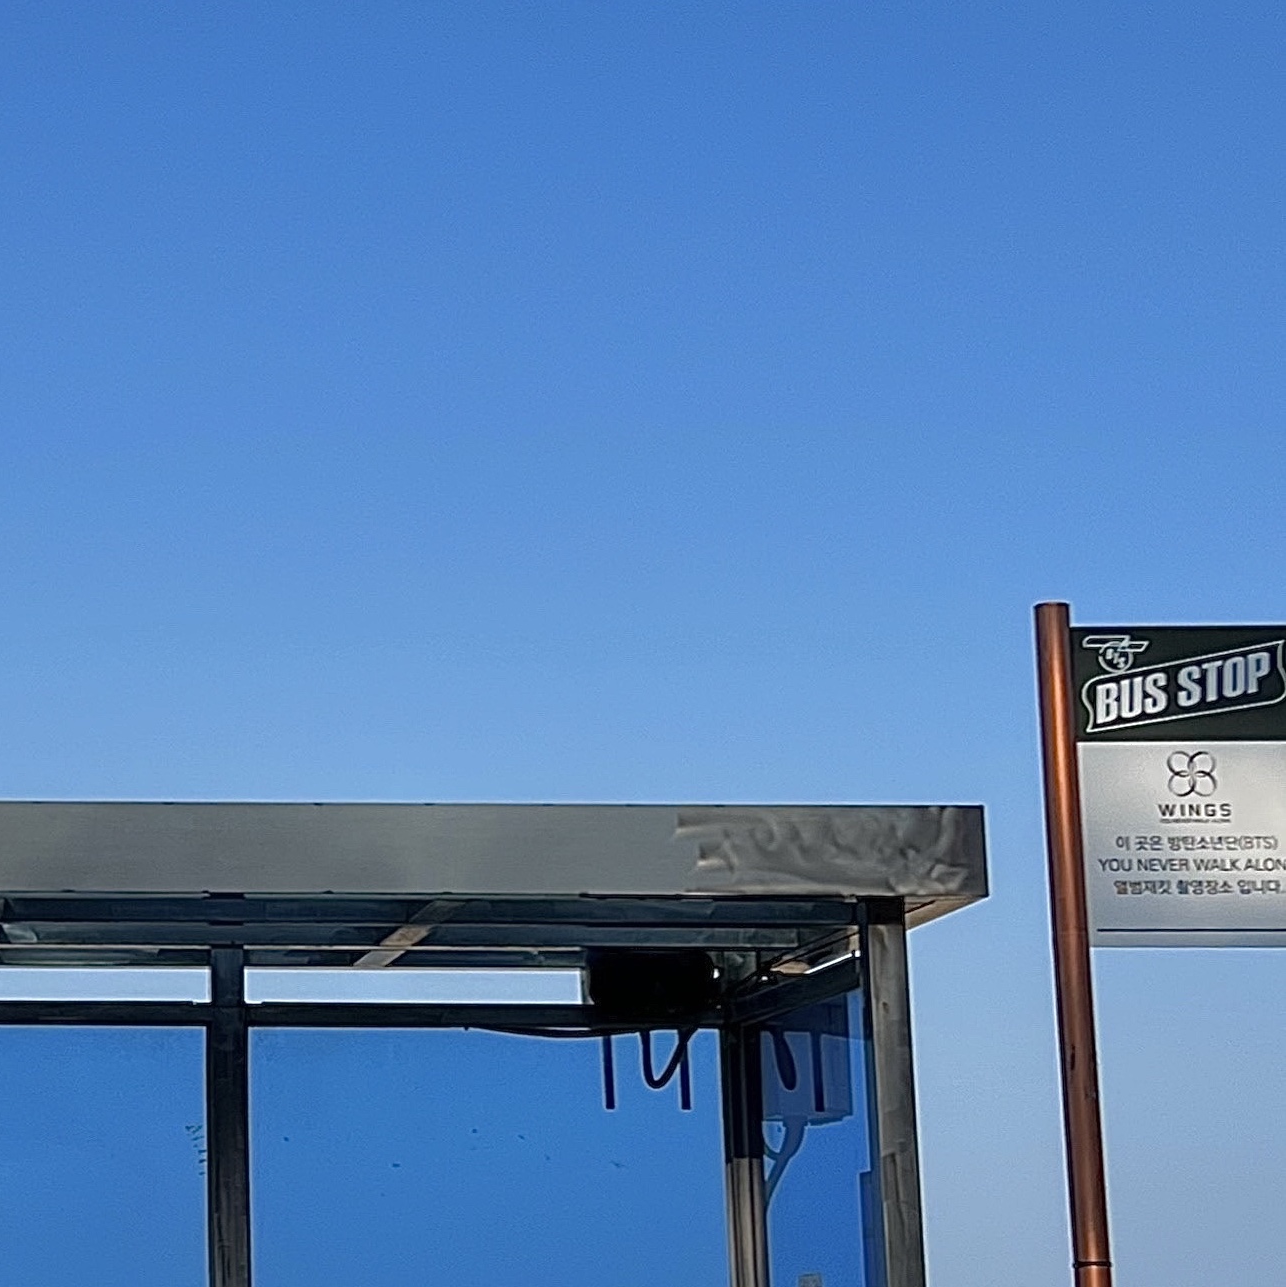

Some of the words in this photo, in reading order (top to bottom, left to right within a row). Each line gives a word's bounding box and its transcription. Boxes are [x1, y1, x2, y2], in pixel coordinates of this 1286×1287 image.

[1096, 672, 1168, 724] BUS
[1177, 652, 1271, 707] STOP
[1158, 803, 1232, 817] WINGS
[1115, 836, 1130, 851] 이
[1135, 835, 1164, 851] 곳은
[1097, 858, 1132, 872] YOU
[1137, 858, 1189, 871] NEVER
[1193, 858, 1243, 871] WALK
